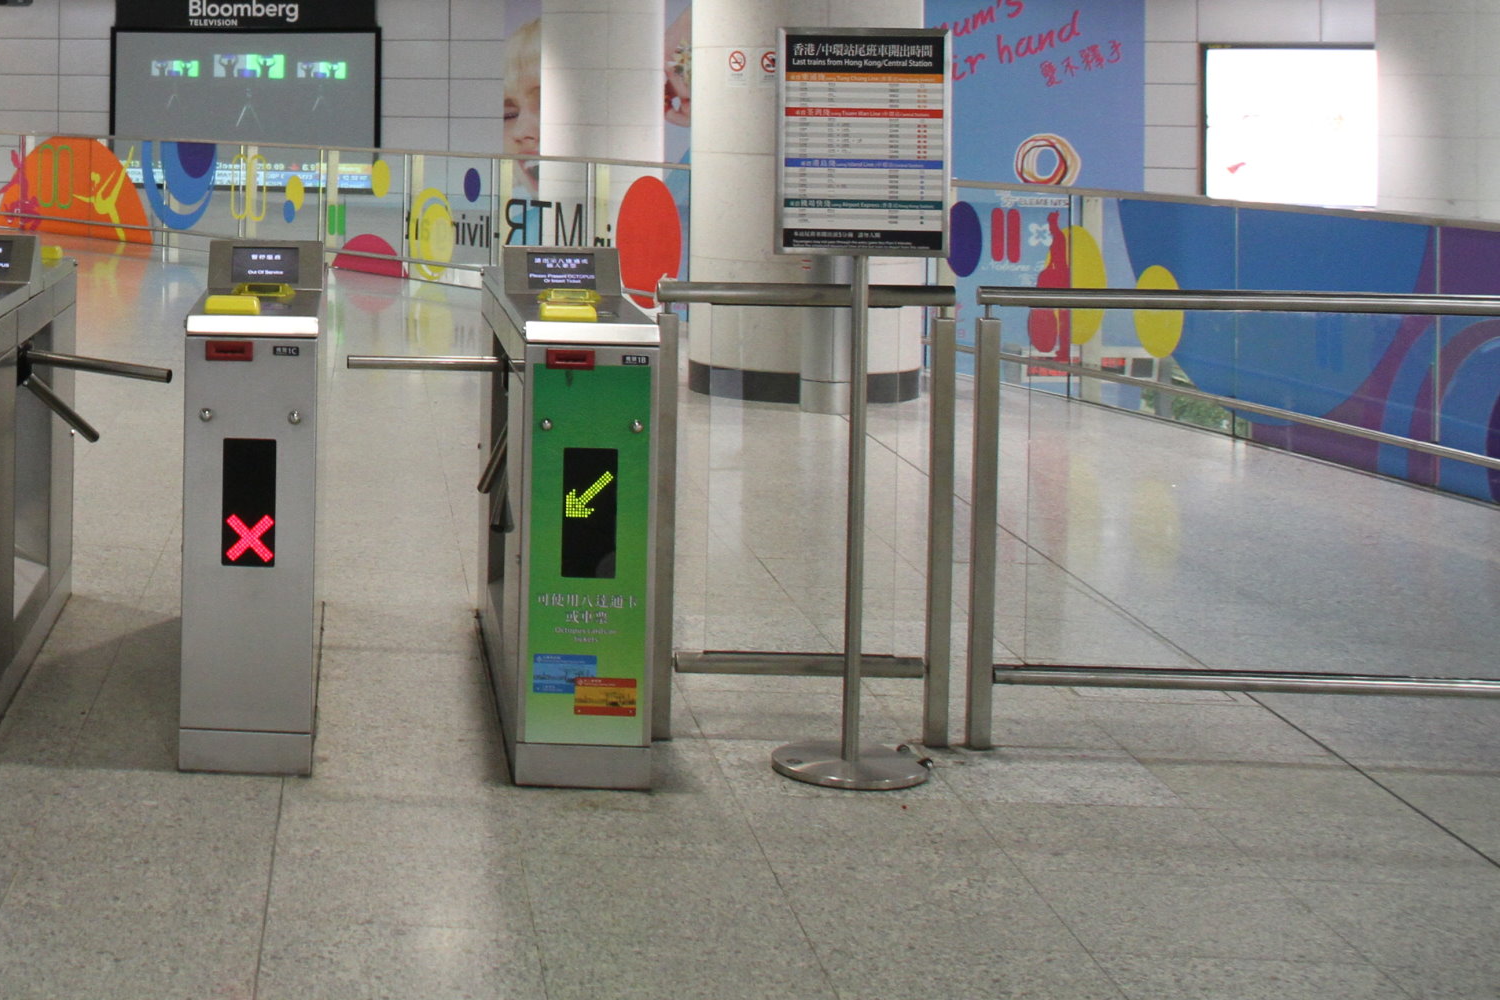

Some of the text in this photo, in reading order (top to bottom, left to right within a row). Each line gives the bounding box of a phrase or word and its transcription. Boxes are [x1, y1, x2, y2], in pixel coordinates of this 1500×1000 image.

[189, 18, 238, 26] TELEVISION
[996, 9, 1082, 65] hand
[792, 57, 933, 68] Last trains from Hong Kong/Central Station
